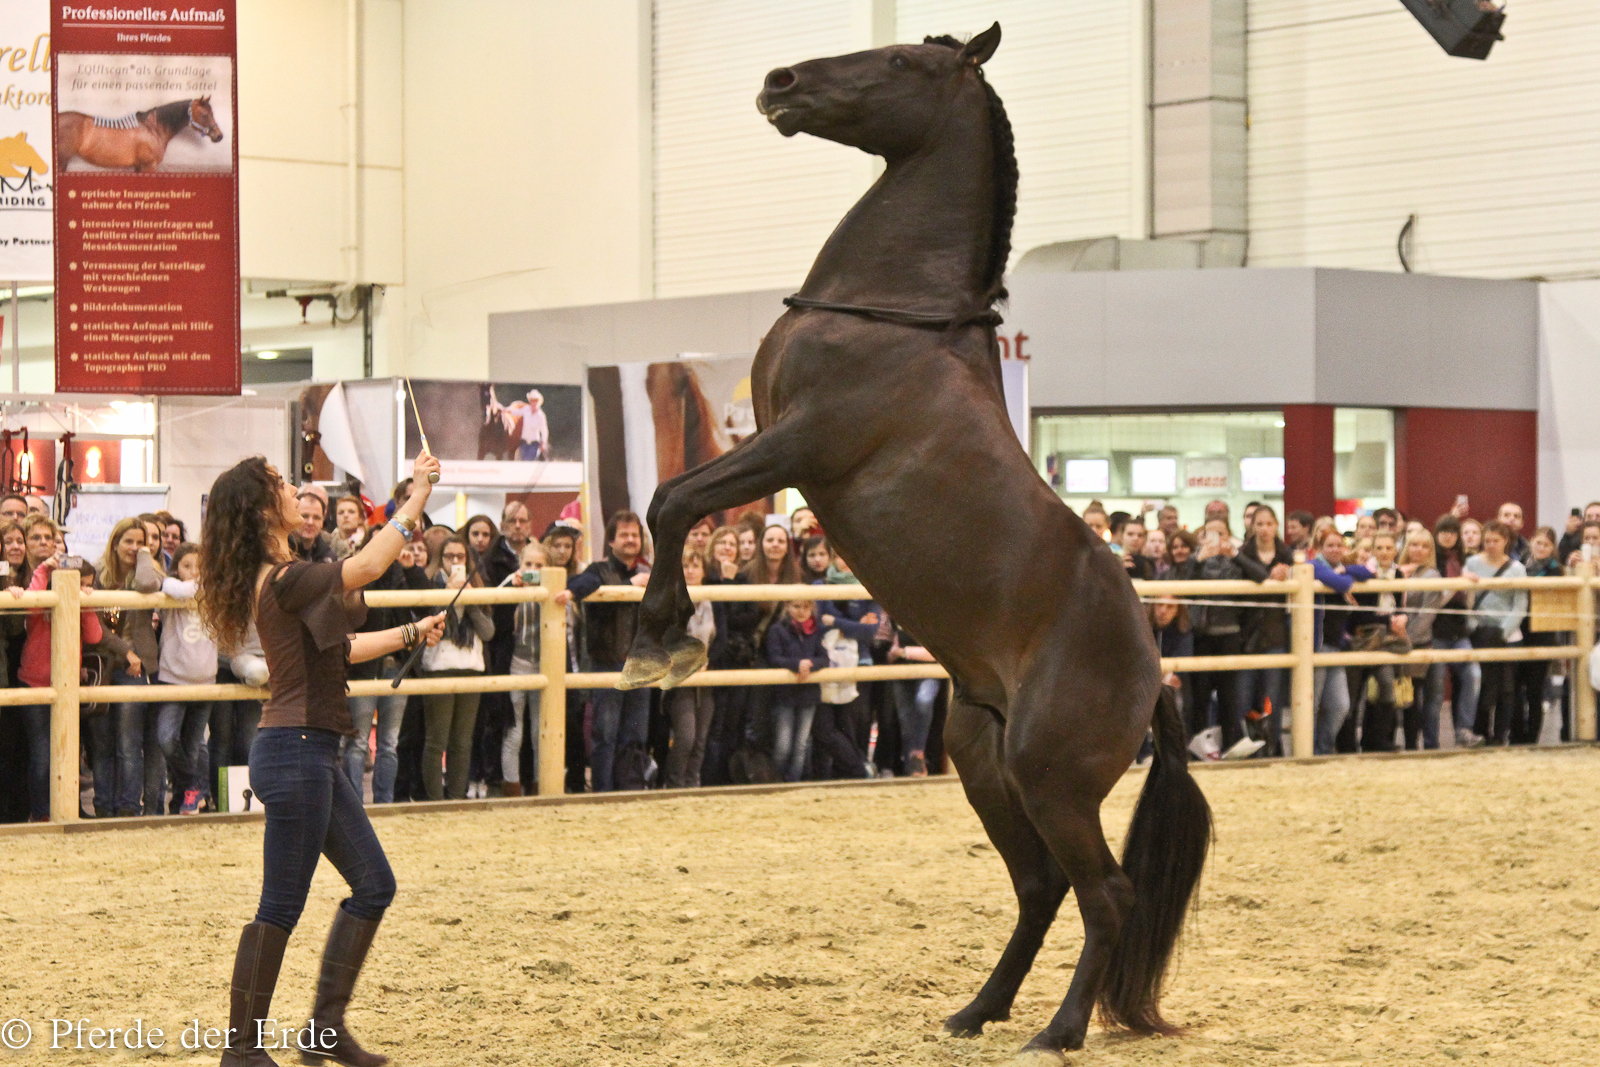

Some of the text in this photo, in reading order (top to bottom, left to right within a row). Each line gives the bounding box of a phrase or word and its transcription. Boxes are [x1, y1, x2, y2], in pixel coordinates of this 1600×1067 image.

[62, 6, 225, 22] Professionelles Aufmaß
[117, 32, 171, 43] Ihres Pferdes
[154, 66, 211, 77] Grundlage
[72, 79, 217, 92] für einen passenden Sattel
[81, 189, 121, 200] optische
[82, 201, 170, 210] nahme des Pferdes
[82, 219, 214, 231] intensives Hinterfragen und
[82, 231, 220, 241] Ausfüllen einer ausführlichen
[82, 242, 178, 251] Messdokumentation
[82, 261, 206, 273] Vermassung der Sattellage
[83, 272, 170, 282] mit verschiedenen
[83, 284, 141, 295] Werkzeugen
[83, 302, 183, 312] Bilderdokumentation
[83, 321, 214, 331] statisches Aufmaß mit Hilfe
[83, 333, 174, 344] eines Messgerippes
[83, 352, 211, 361] statisches Aufmaß mit dem
[84, 363, 167, 374] Topographen PRO
